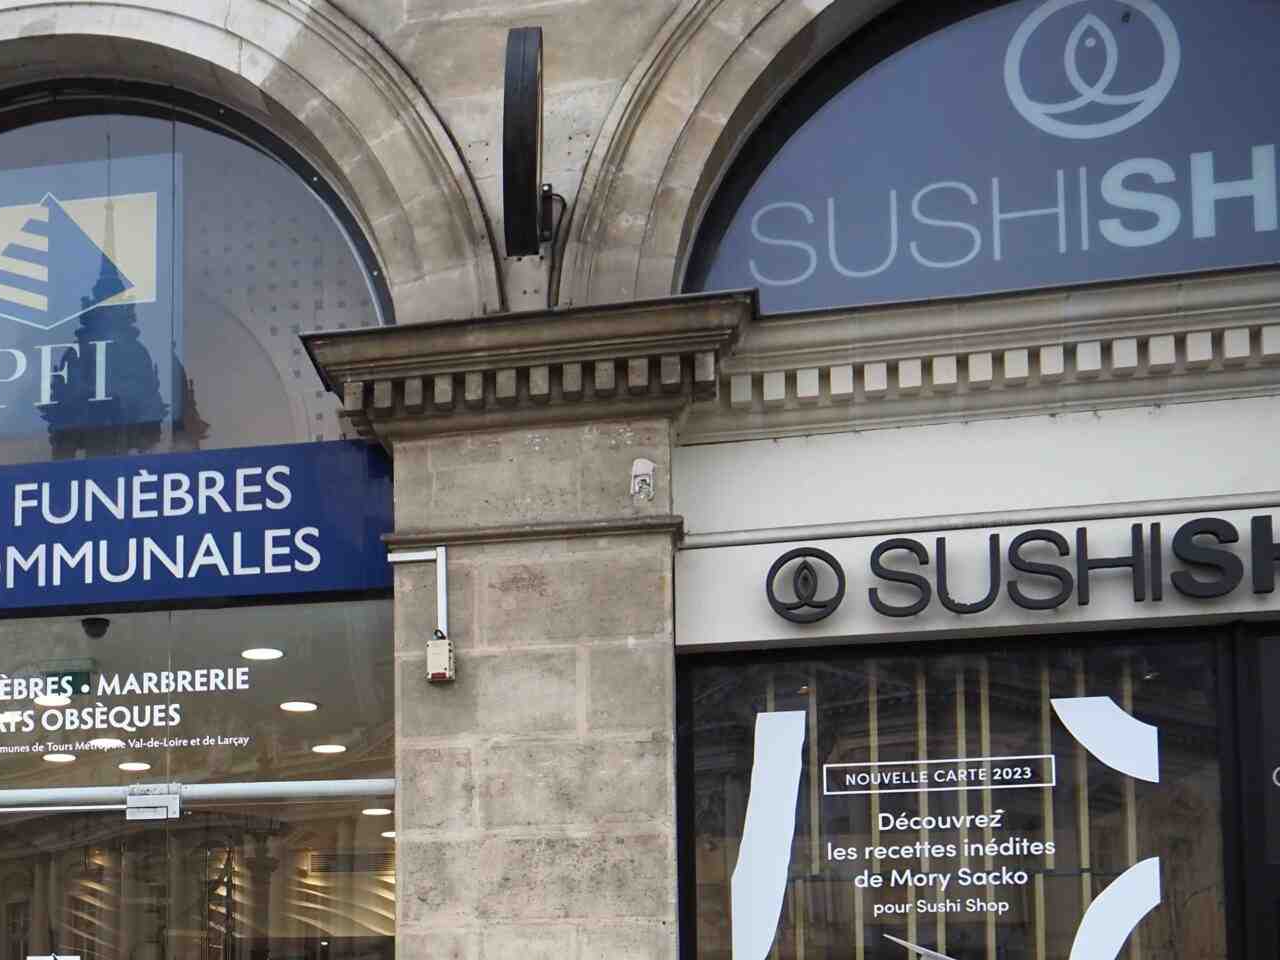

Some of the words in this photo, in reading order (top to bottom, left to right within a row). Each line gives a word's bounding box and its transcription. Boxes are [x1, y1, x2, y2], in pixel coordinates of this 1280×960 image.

[13, 465, 293, 527] FUNÈBRES
[97, 667, 250, 697] MARBRERIE
[41, 702, 182, 732] OBSÈQUES
[31, 742, 45, 752] de
[47, 742, 73, 752] Tours
[128, 737, 188, 749] Val-de-Loire
[190, 737, 201, 747] et
[202, 735, 215, 746] de
[217, 735, 250, 747] Larçay
[845, 770, 929, 786] NOUVELLE
[933, 768, 988, 783] CARTE
[992, 767, 1032, 780] 2023
[878, 812, 1003, 832] Découvrez
[827, 843, 858, 861] les
[865, 842, 957, 860] recettes
[963, 837, 1057, 857] inédites
[854, 869, 884, 888] de
[890, 869, 951, 891] Mory
[958, 866, 1029, 886] Sacko
[873, 902, 913, 918] pour
[916, 898, 961, 913] Sushi
[965, 898, 1009, 916] Shop
